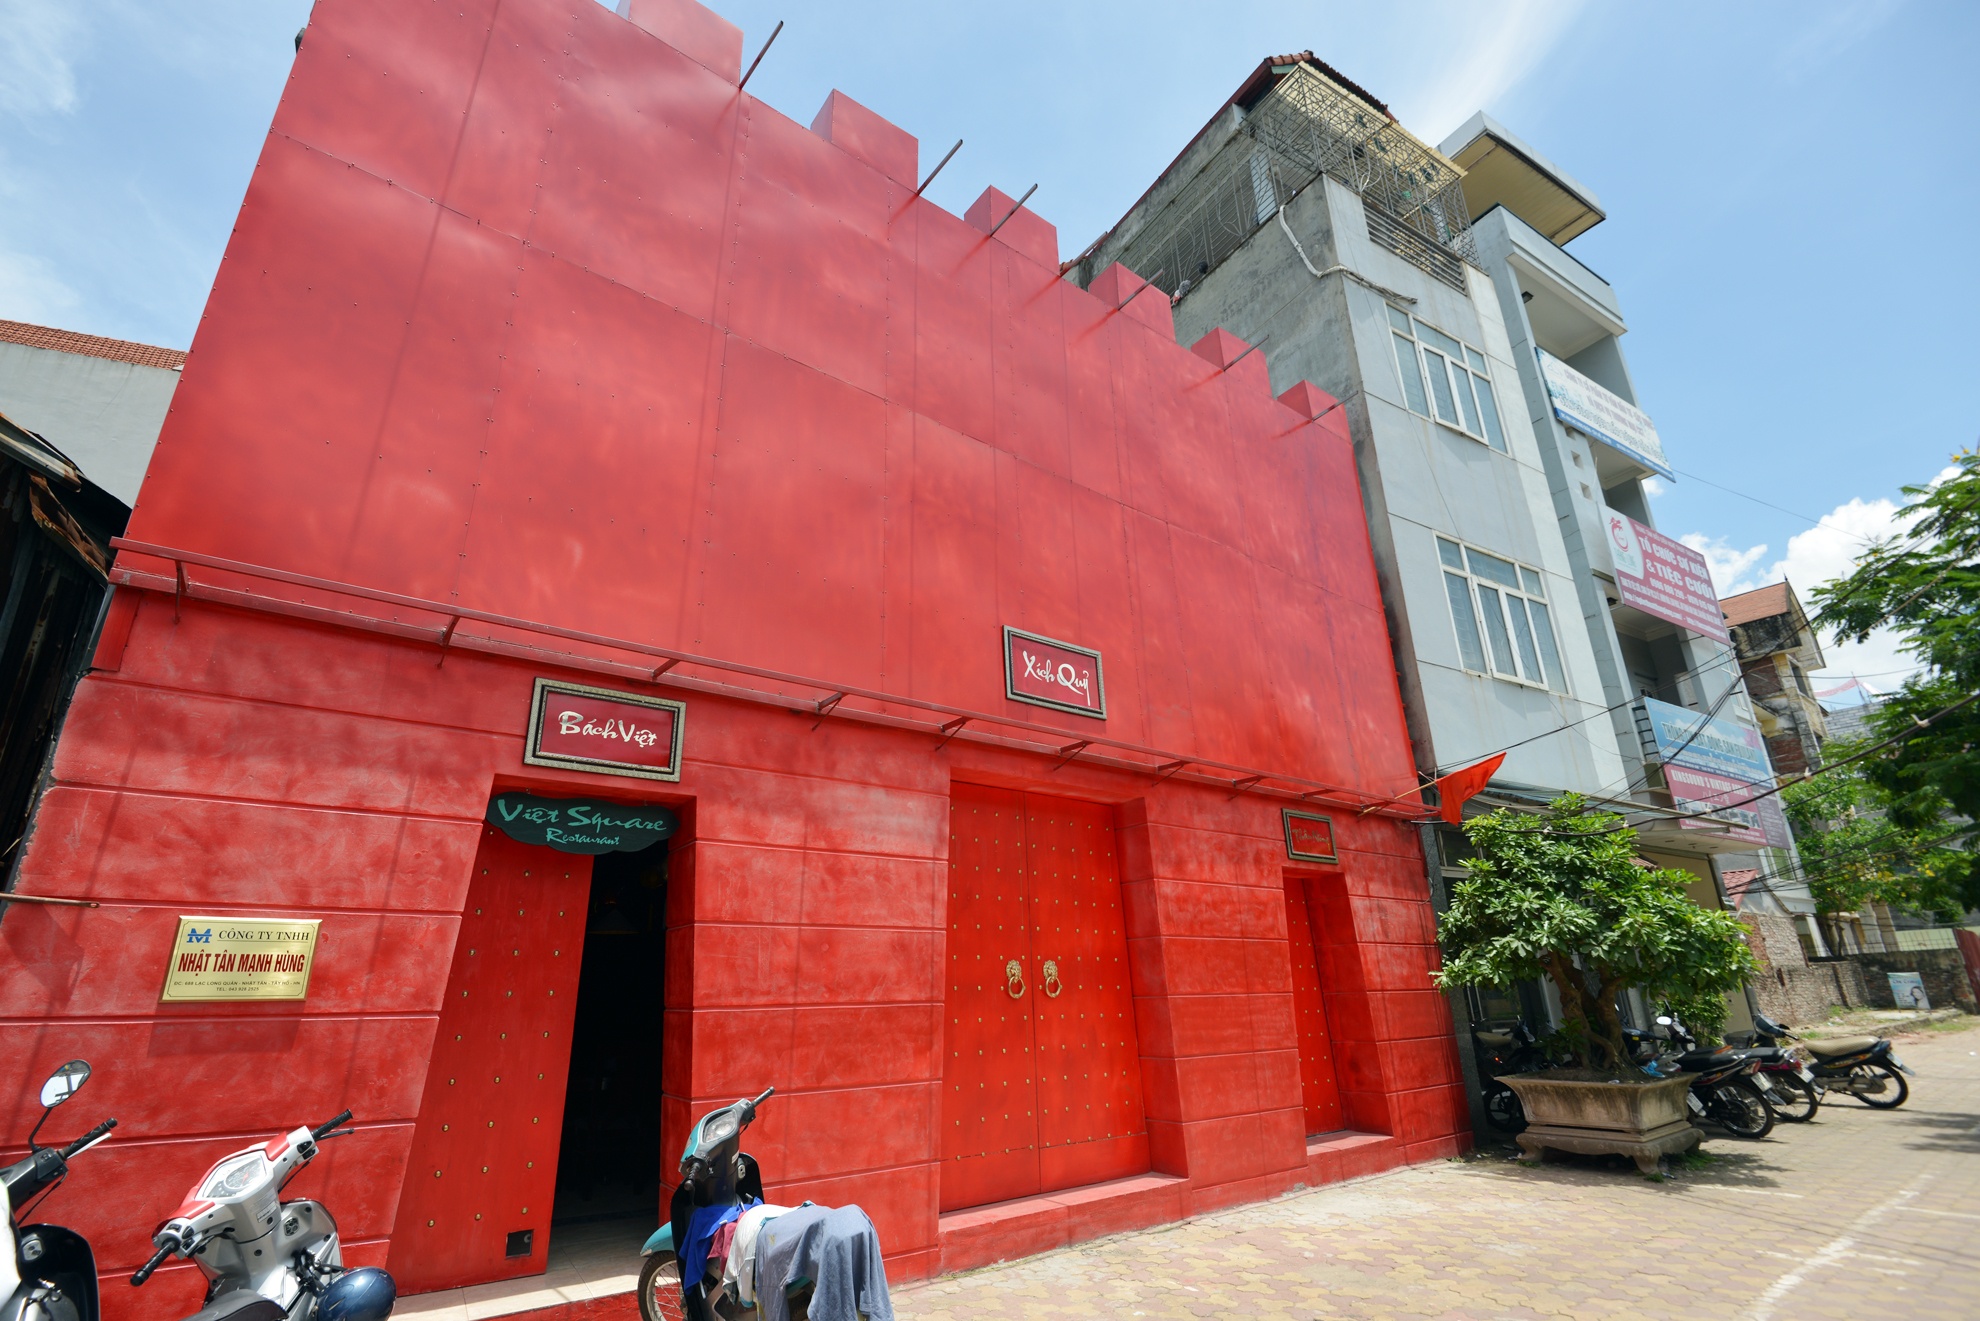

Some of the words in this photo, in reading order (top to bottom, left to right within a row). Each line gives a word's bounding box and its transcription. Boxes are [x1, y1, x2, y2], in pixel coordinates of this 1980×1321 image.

[1638, 535, 1653, 554] TỔ
[1652, 543, 1677, 565] CHỨC
[1677, 554, 1690, 572] SỰ
[1690, 560, 1708, 580] KIỆN
[1645, 559, 1656, 574] &
[1654, 560, 1683, 586] TIỆC
[1685, 576, 1715, 600] CƯỚI
[1022, 650, 1055, 683] Xích
[1056, 663, 1091, 706] Quỷ
[558, 710, 618, 739] Bách
[618, 719, 658, 748] Việt
[497, 799, 559, 824] Việt
[567, 806, 667, 833] Square
[546, 827, 620, 846] Restaurant
[218, 928, 254, 940] CÔNG
[258, 931, 273, 940] TY
[277, 932, 310, 941] TNHH
[177, 949, 212, 976] NHẬT
[213, 949, 237, 972] TÂN
[237, 953, 273, 976] MẠNH
